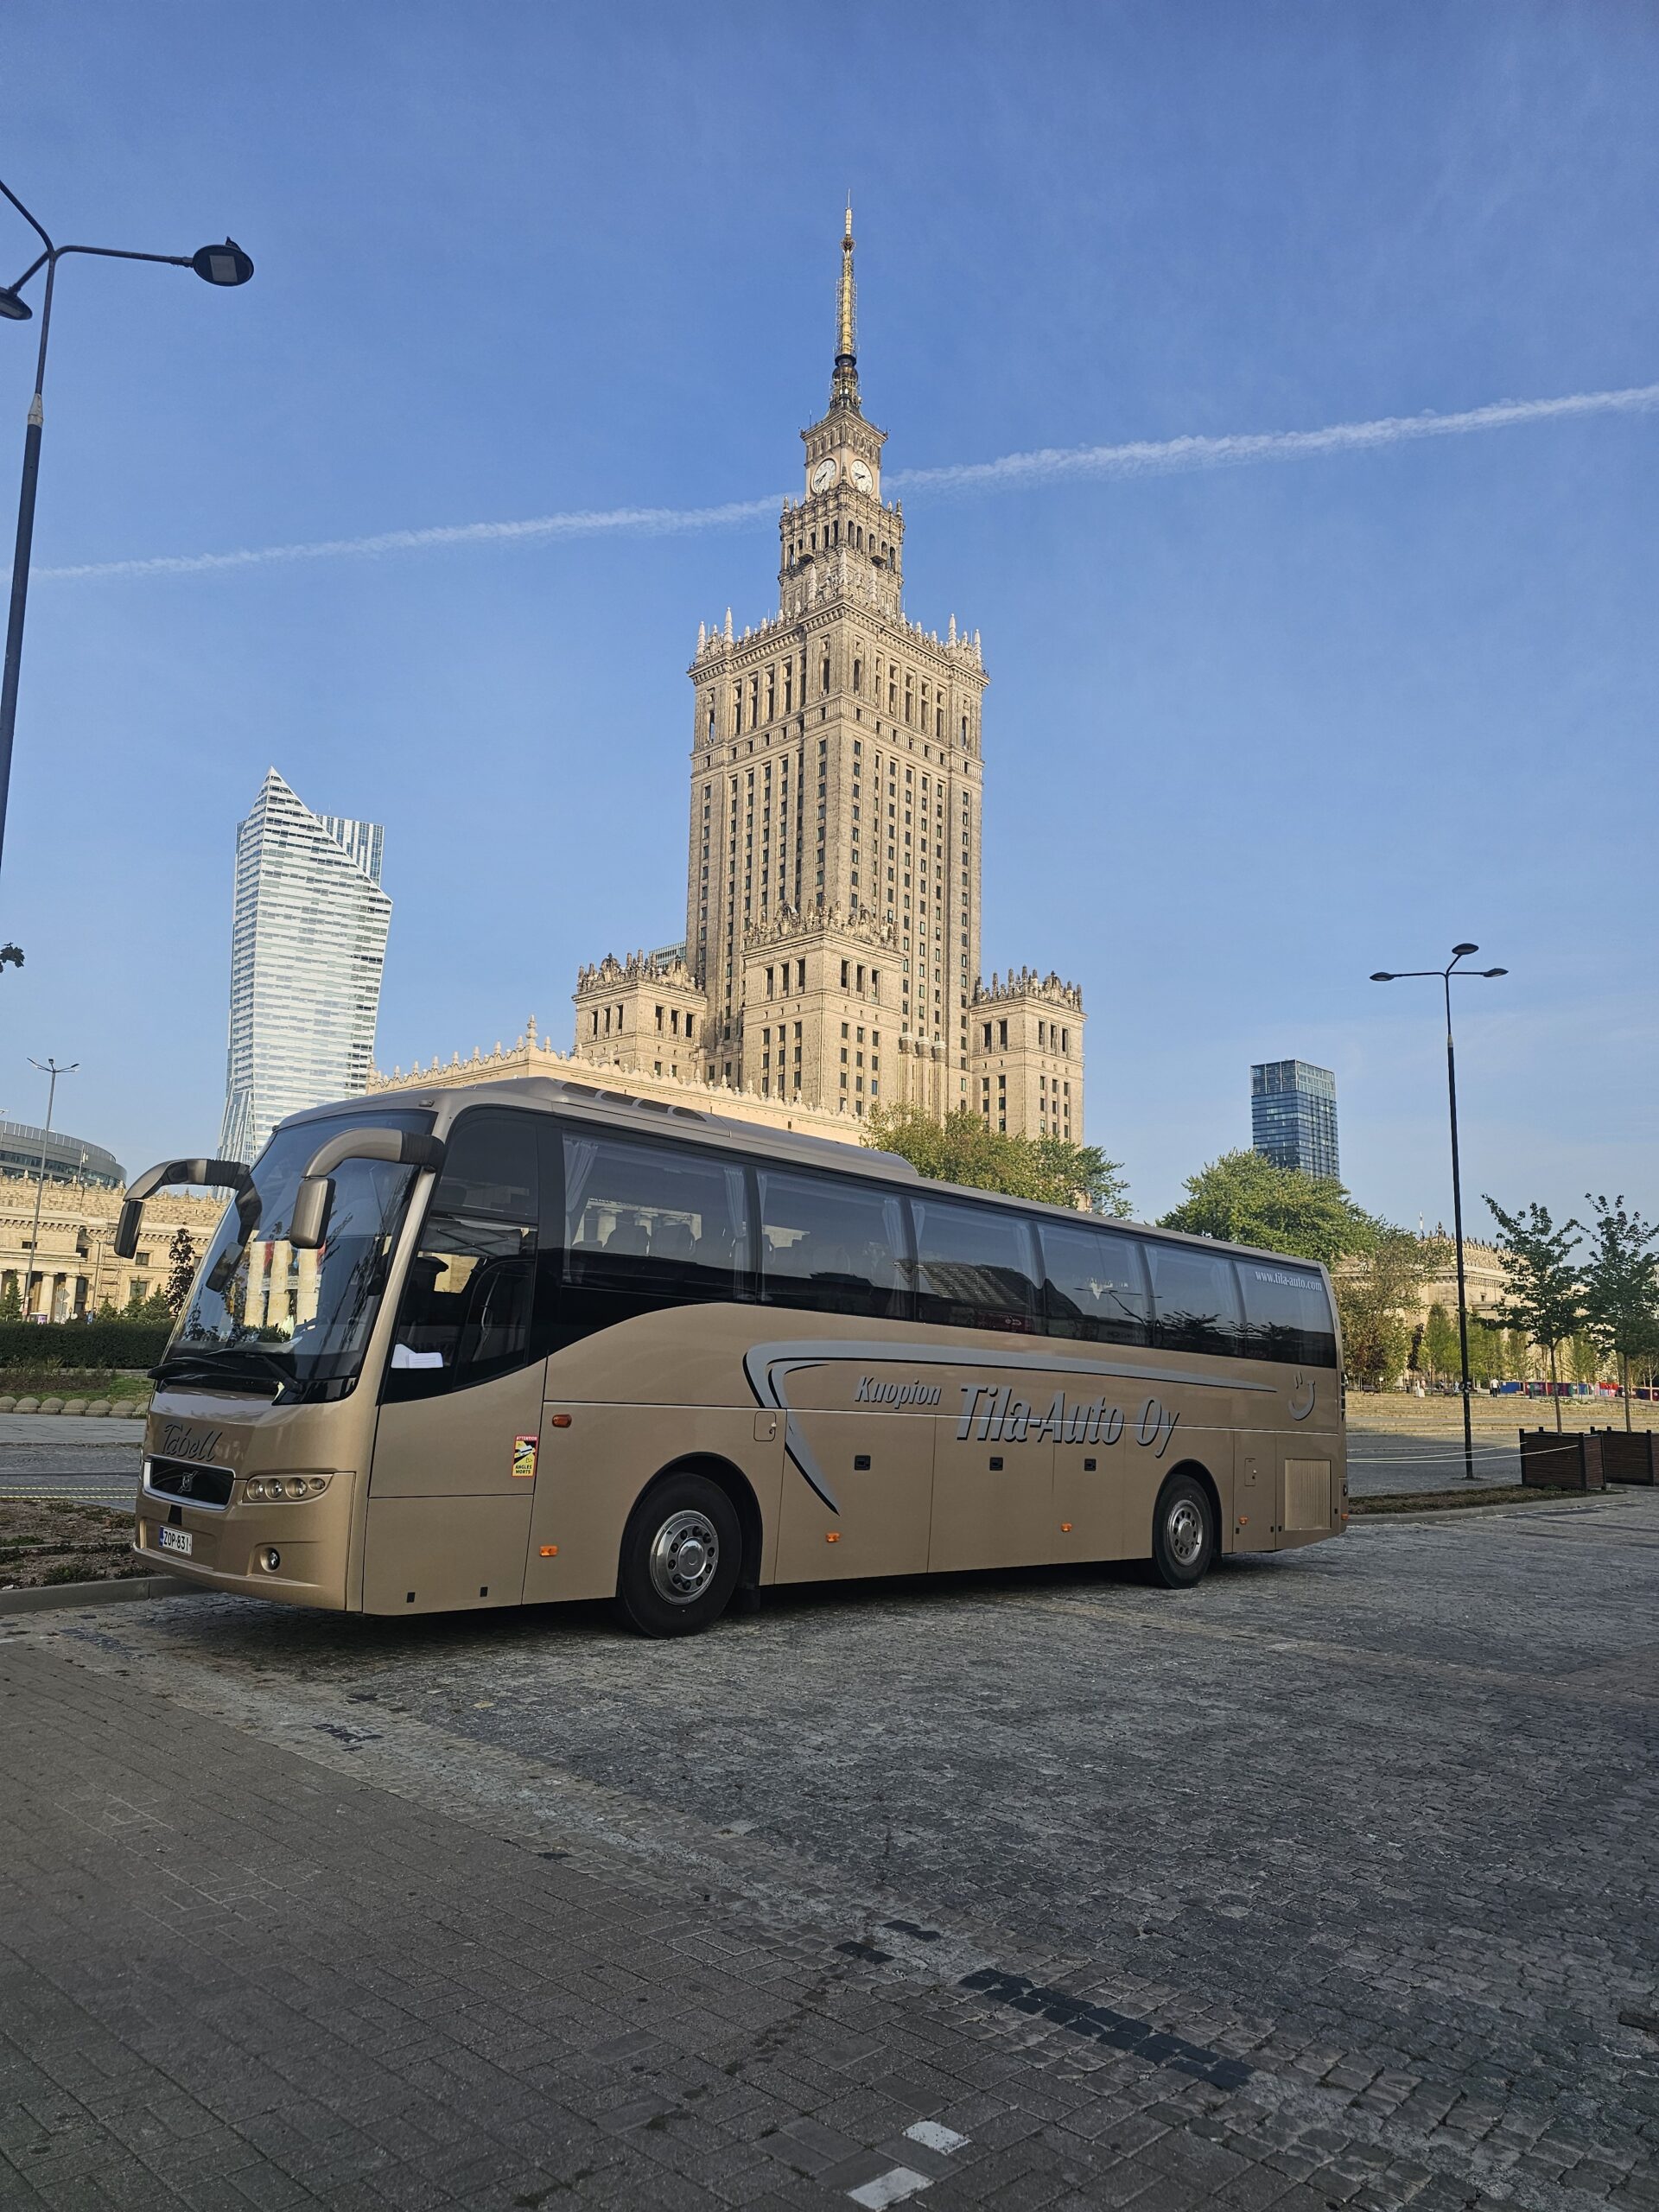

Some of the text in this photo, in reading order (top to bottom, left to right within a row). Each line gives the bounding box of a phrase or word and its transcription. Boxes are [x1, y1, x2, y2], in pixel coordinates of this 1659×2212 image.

[1255, 1271, 1322, 1291] www.tila-auto.com
[855, 1376, 1180, 1459] Kuopion Tila-Auto Oy
